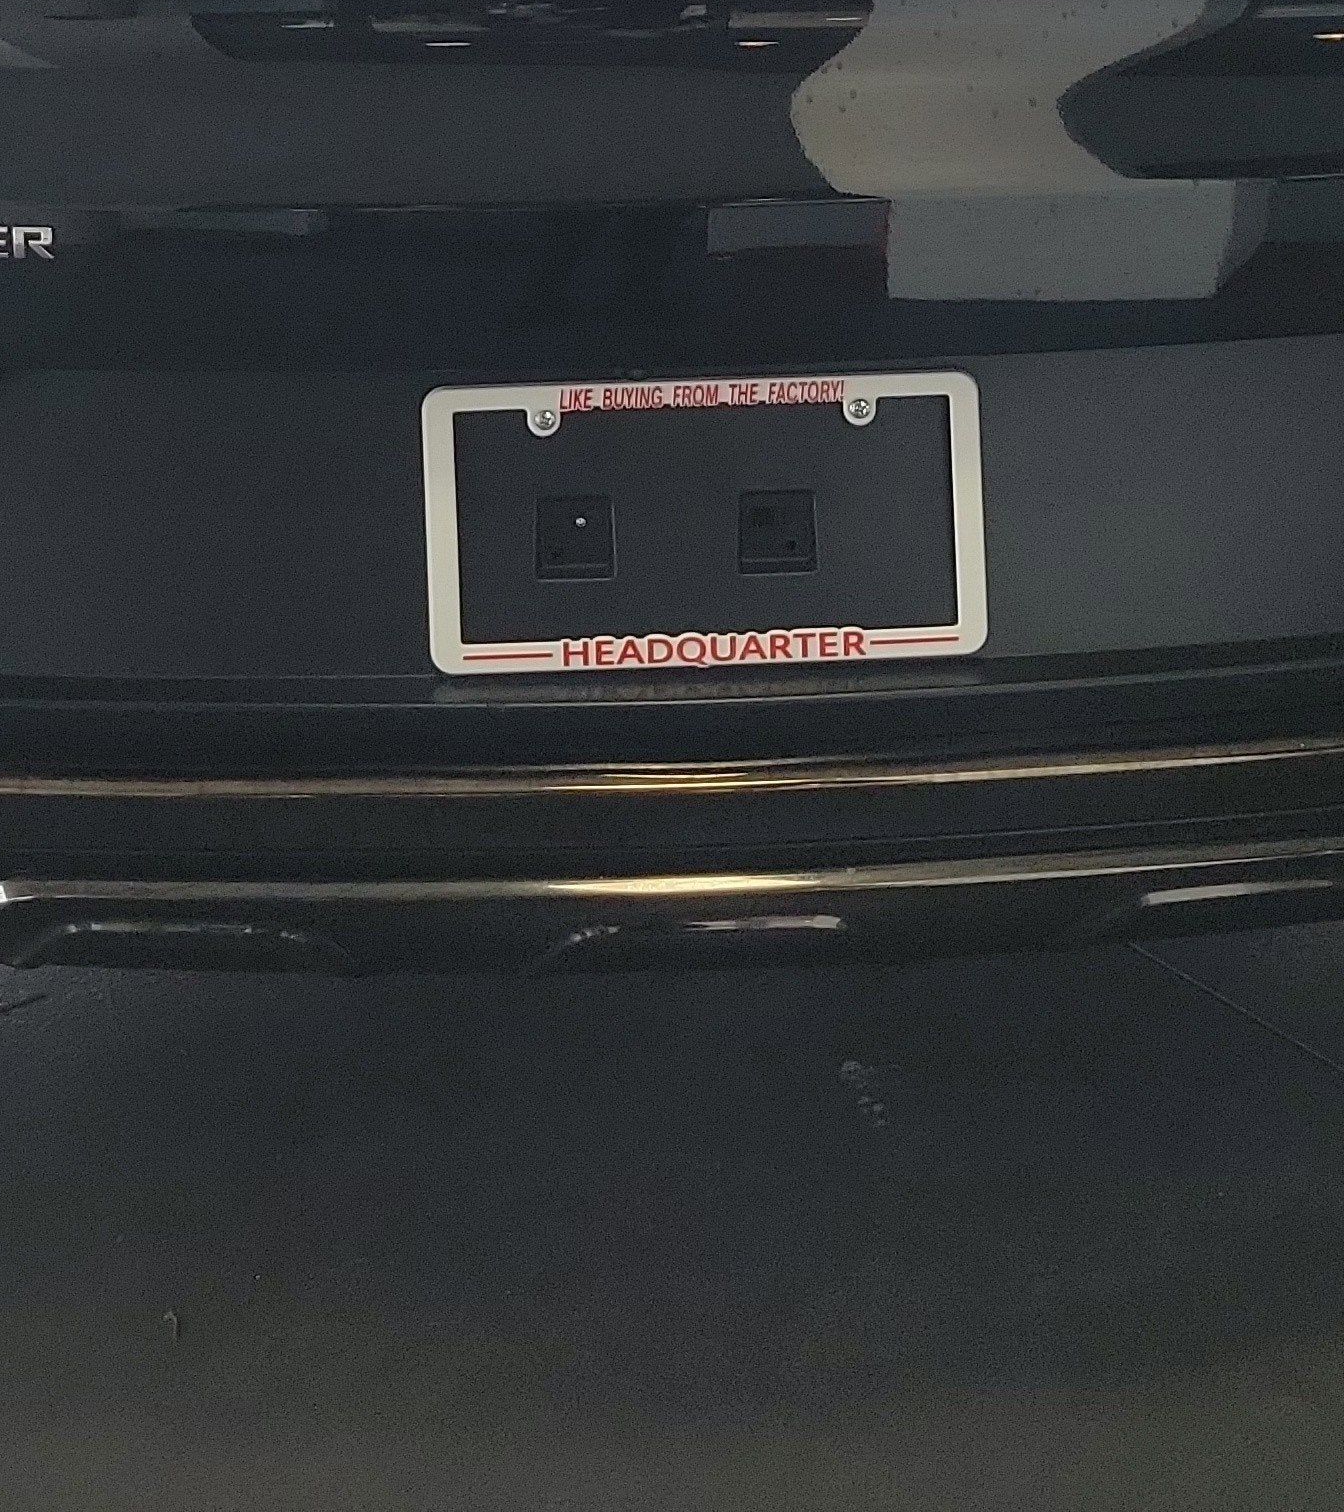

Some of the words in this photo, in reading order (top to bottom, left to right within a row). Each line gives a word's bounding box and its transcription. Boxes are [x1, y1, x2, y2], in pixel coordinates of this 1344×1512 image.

[559, 389, 594, 410] LIKE
[602, 387, 664, 409] BUYING
[672, 385, 720, 406] FROM
[728, 383, 759, 405] THE
[767, 380, 846, 404] FACTORY!
[562, 631, 866, 666] HEADQUARTER
